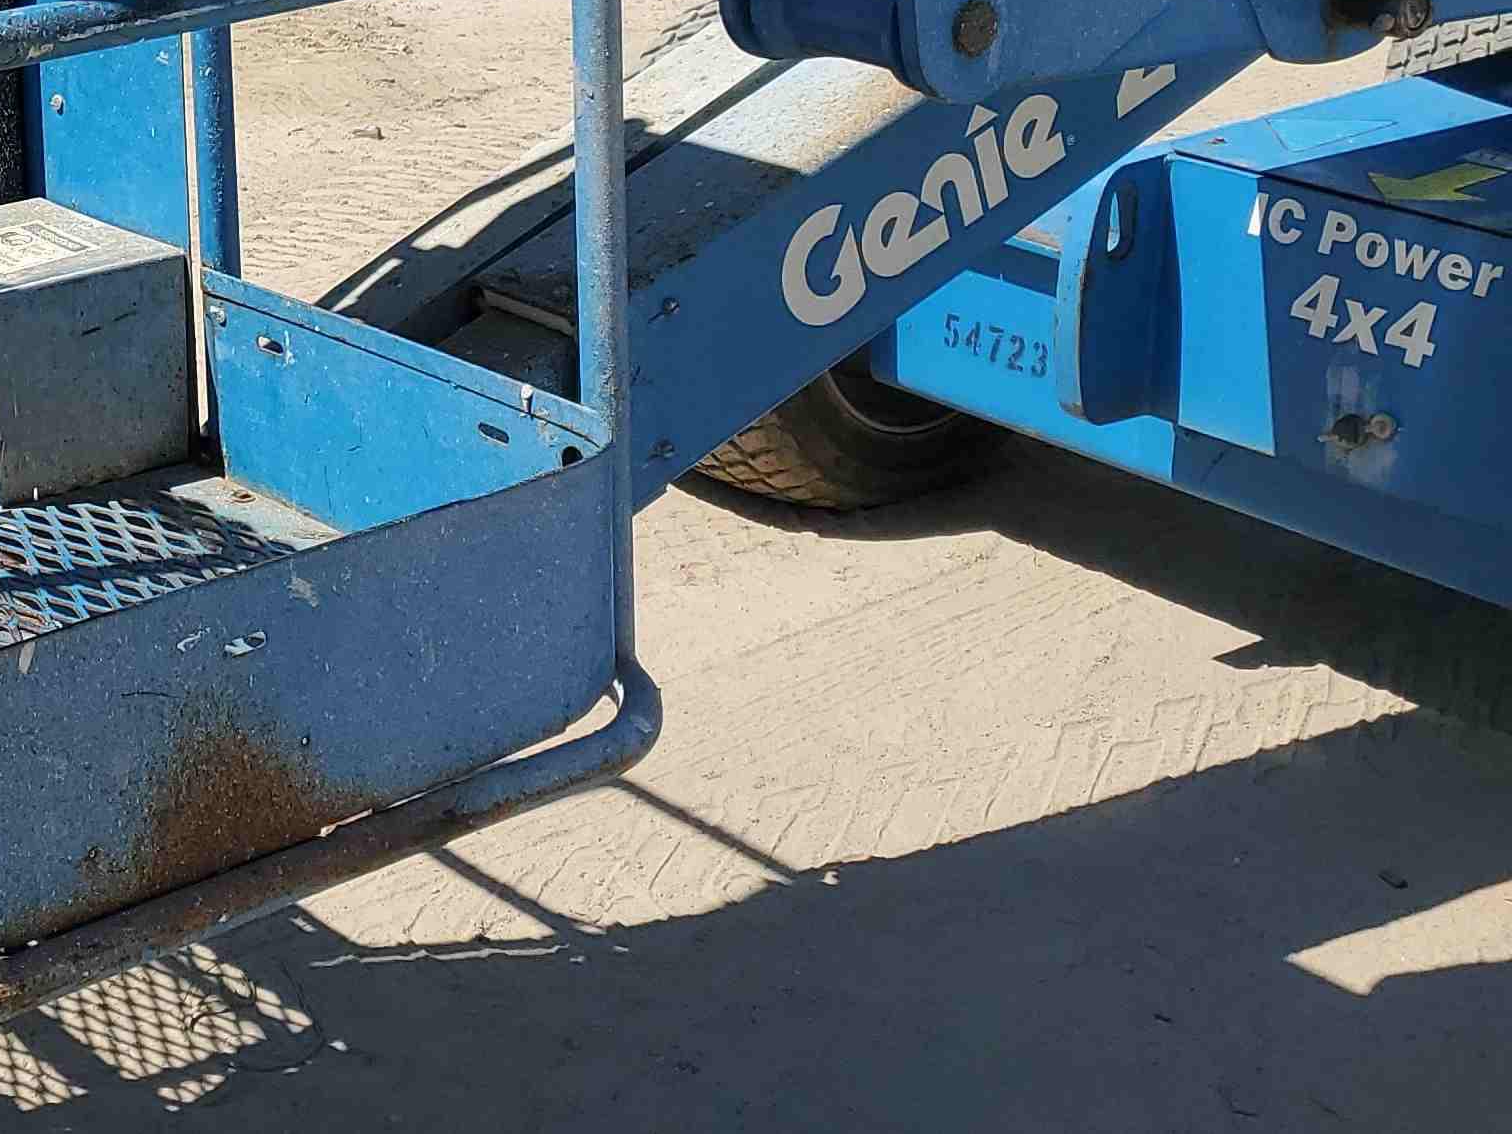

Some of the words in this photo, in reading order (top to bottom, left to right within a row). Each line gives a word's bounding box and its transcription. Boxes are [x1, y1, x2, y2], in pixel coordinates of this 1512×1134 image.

[782, 94, 1066, 326] Genie
[1247, 192, 1307, 245] IC
[1317, 209, 1505, 299] Power
[944, 312, 1049, 379] 54723
[1289, 273, 1438, 369] 4x4
